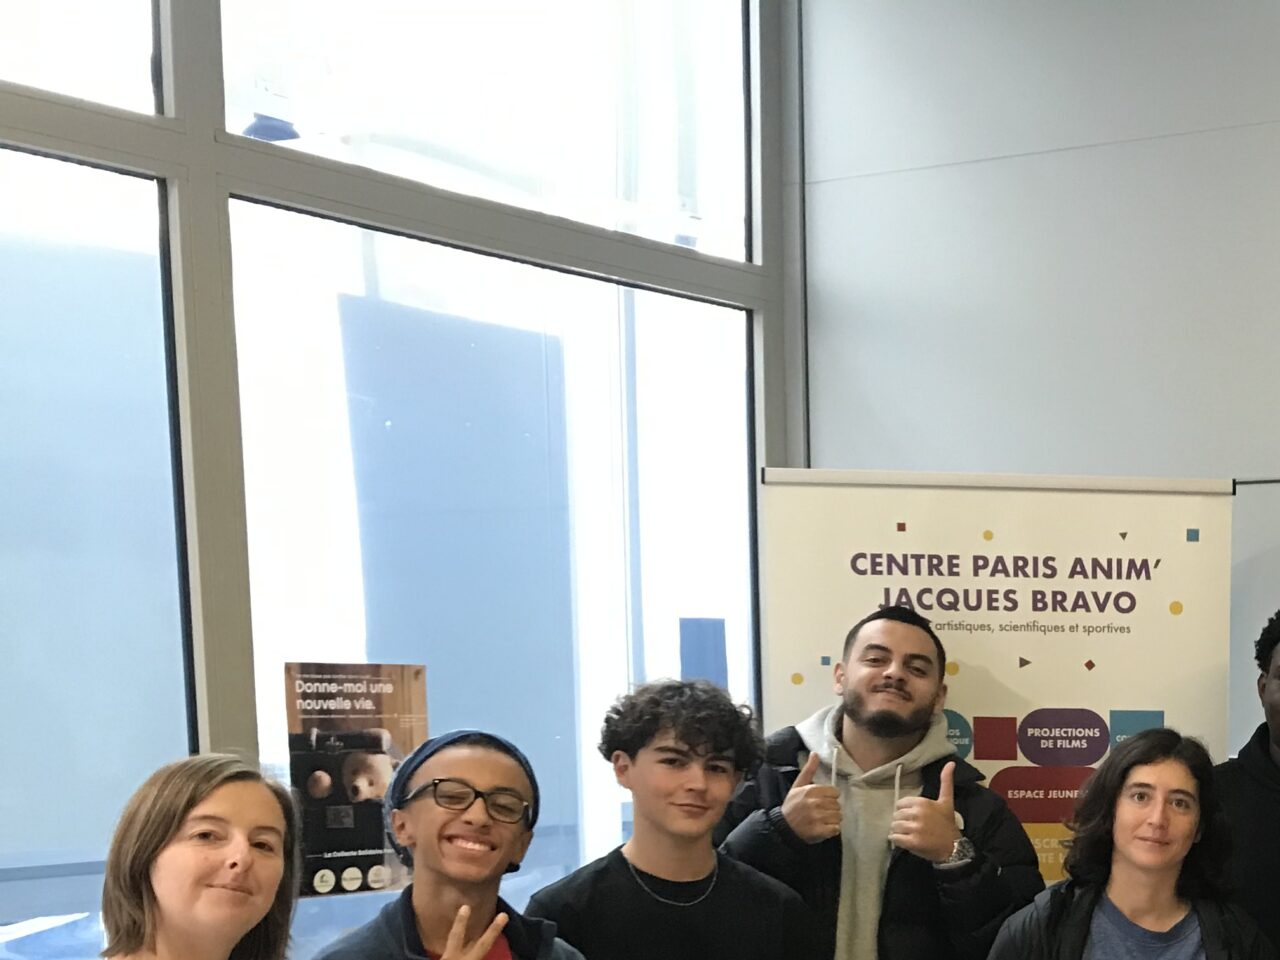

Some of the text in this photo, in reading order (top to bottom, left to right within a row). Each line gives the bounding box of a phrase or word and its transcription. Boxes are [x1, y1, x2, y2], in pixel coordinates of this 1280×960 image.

[850, 552, 1162, 581] CENTRE PARIS ANIM'
[879, 587, 1137, 614] JACQUES BRAVO
[935, 620, 1132, 636] artistiques, scientifiques et sportives
[295, 680, 394, 694] Donne-moi une
[296, 697, 352, 710] nouvelle
[1027, 727, 1100, 738] PROJECTIONS
[1040, 740, 1088, 748] DE FILMS
[1007, 790, 1044, 799] ESPACE
